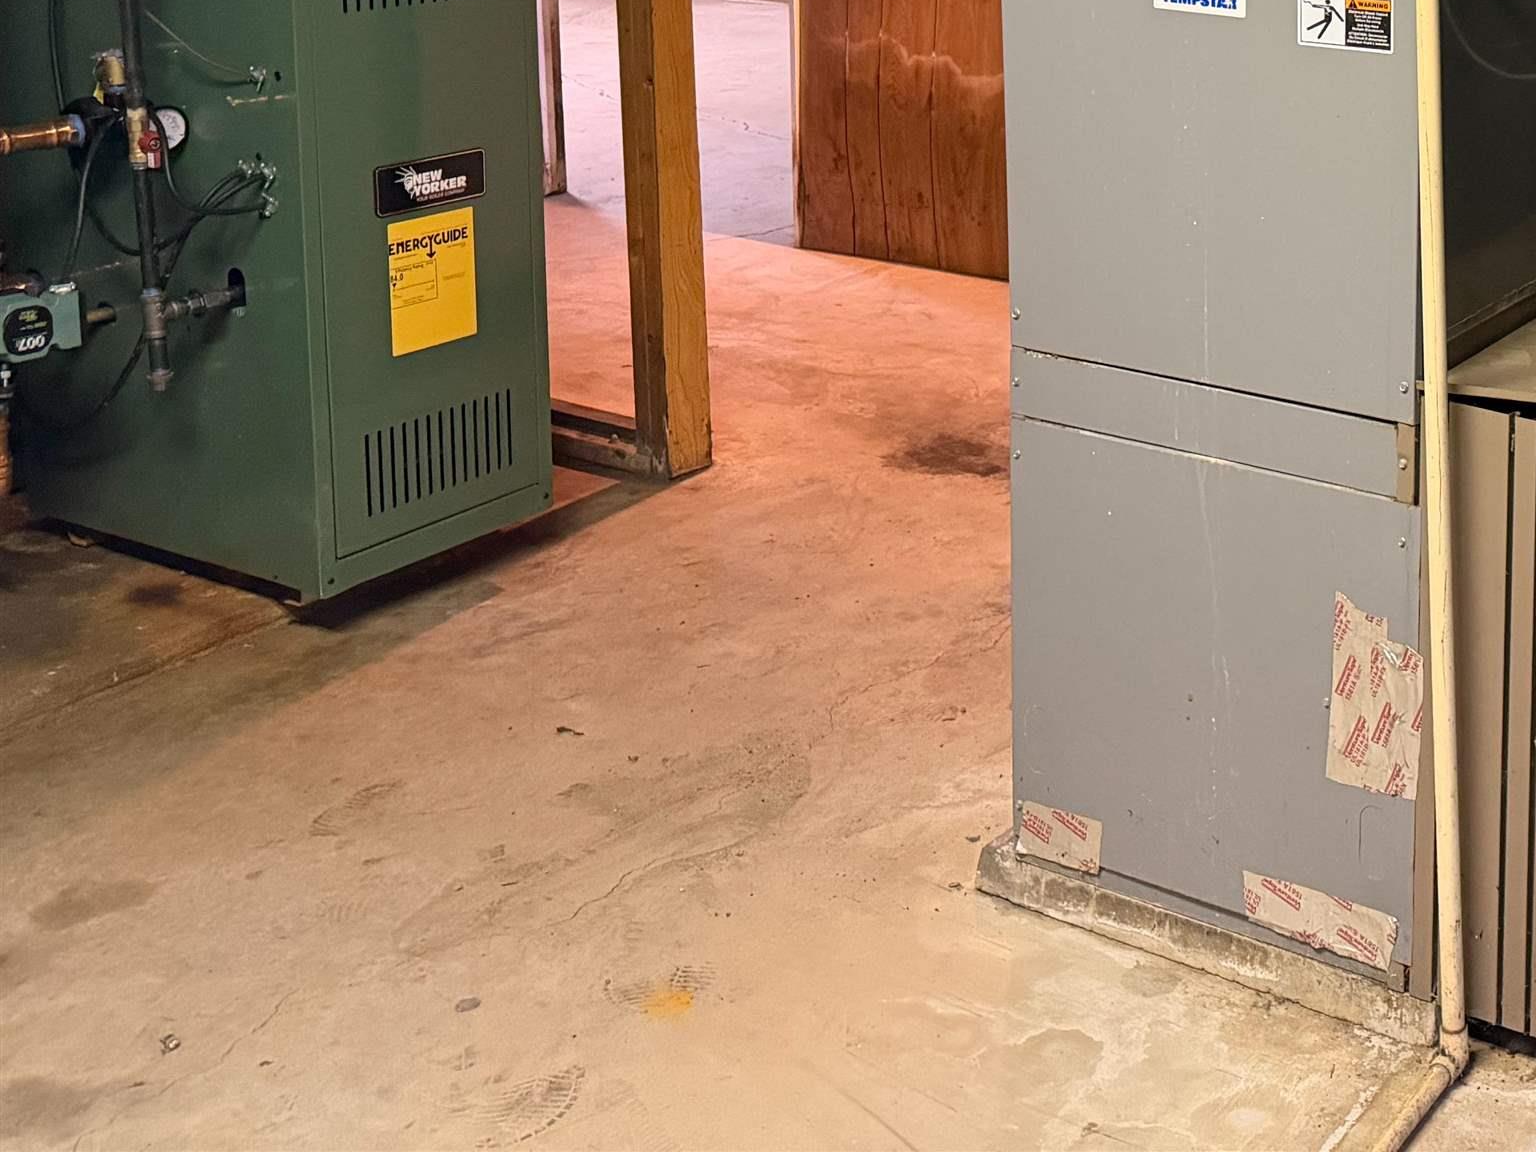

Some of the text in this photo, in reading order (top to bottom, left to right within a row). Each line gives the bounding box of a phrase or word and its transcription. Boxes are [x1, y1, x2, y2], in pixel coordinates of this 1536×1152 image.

[1358, 1, 1389, 10] WARNING
[413, 168, 443, 186] NEW
[414, 175, 467, 197] YORKER
[388, 226, 469, 257] ENERGYGUIDE
[18, 334, 46, 352] 007
